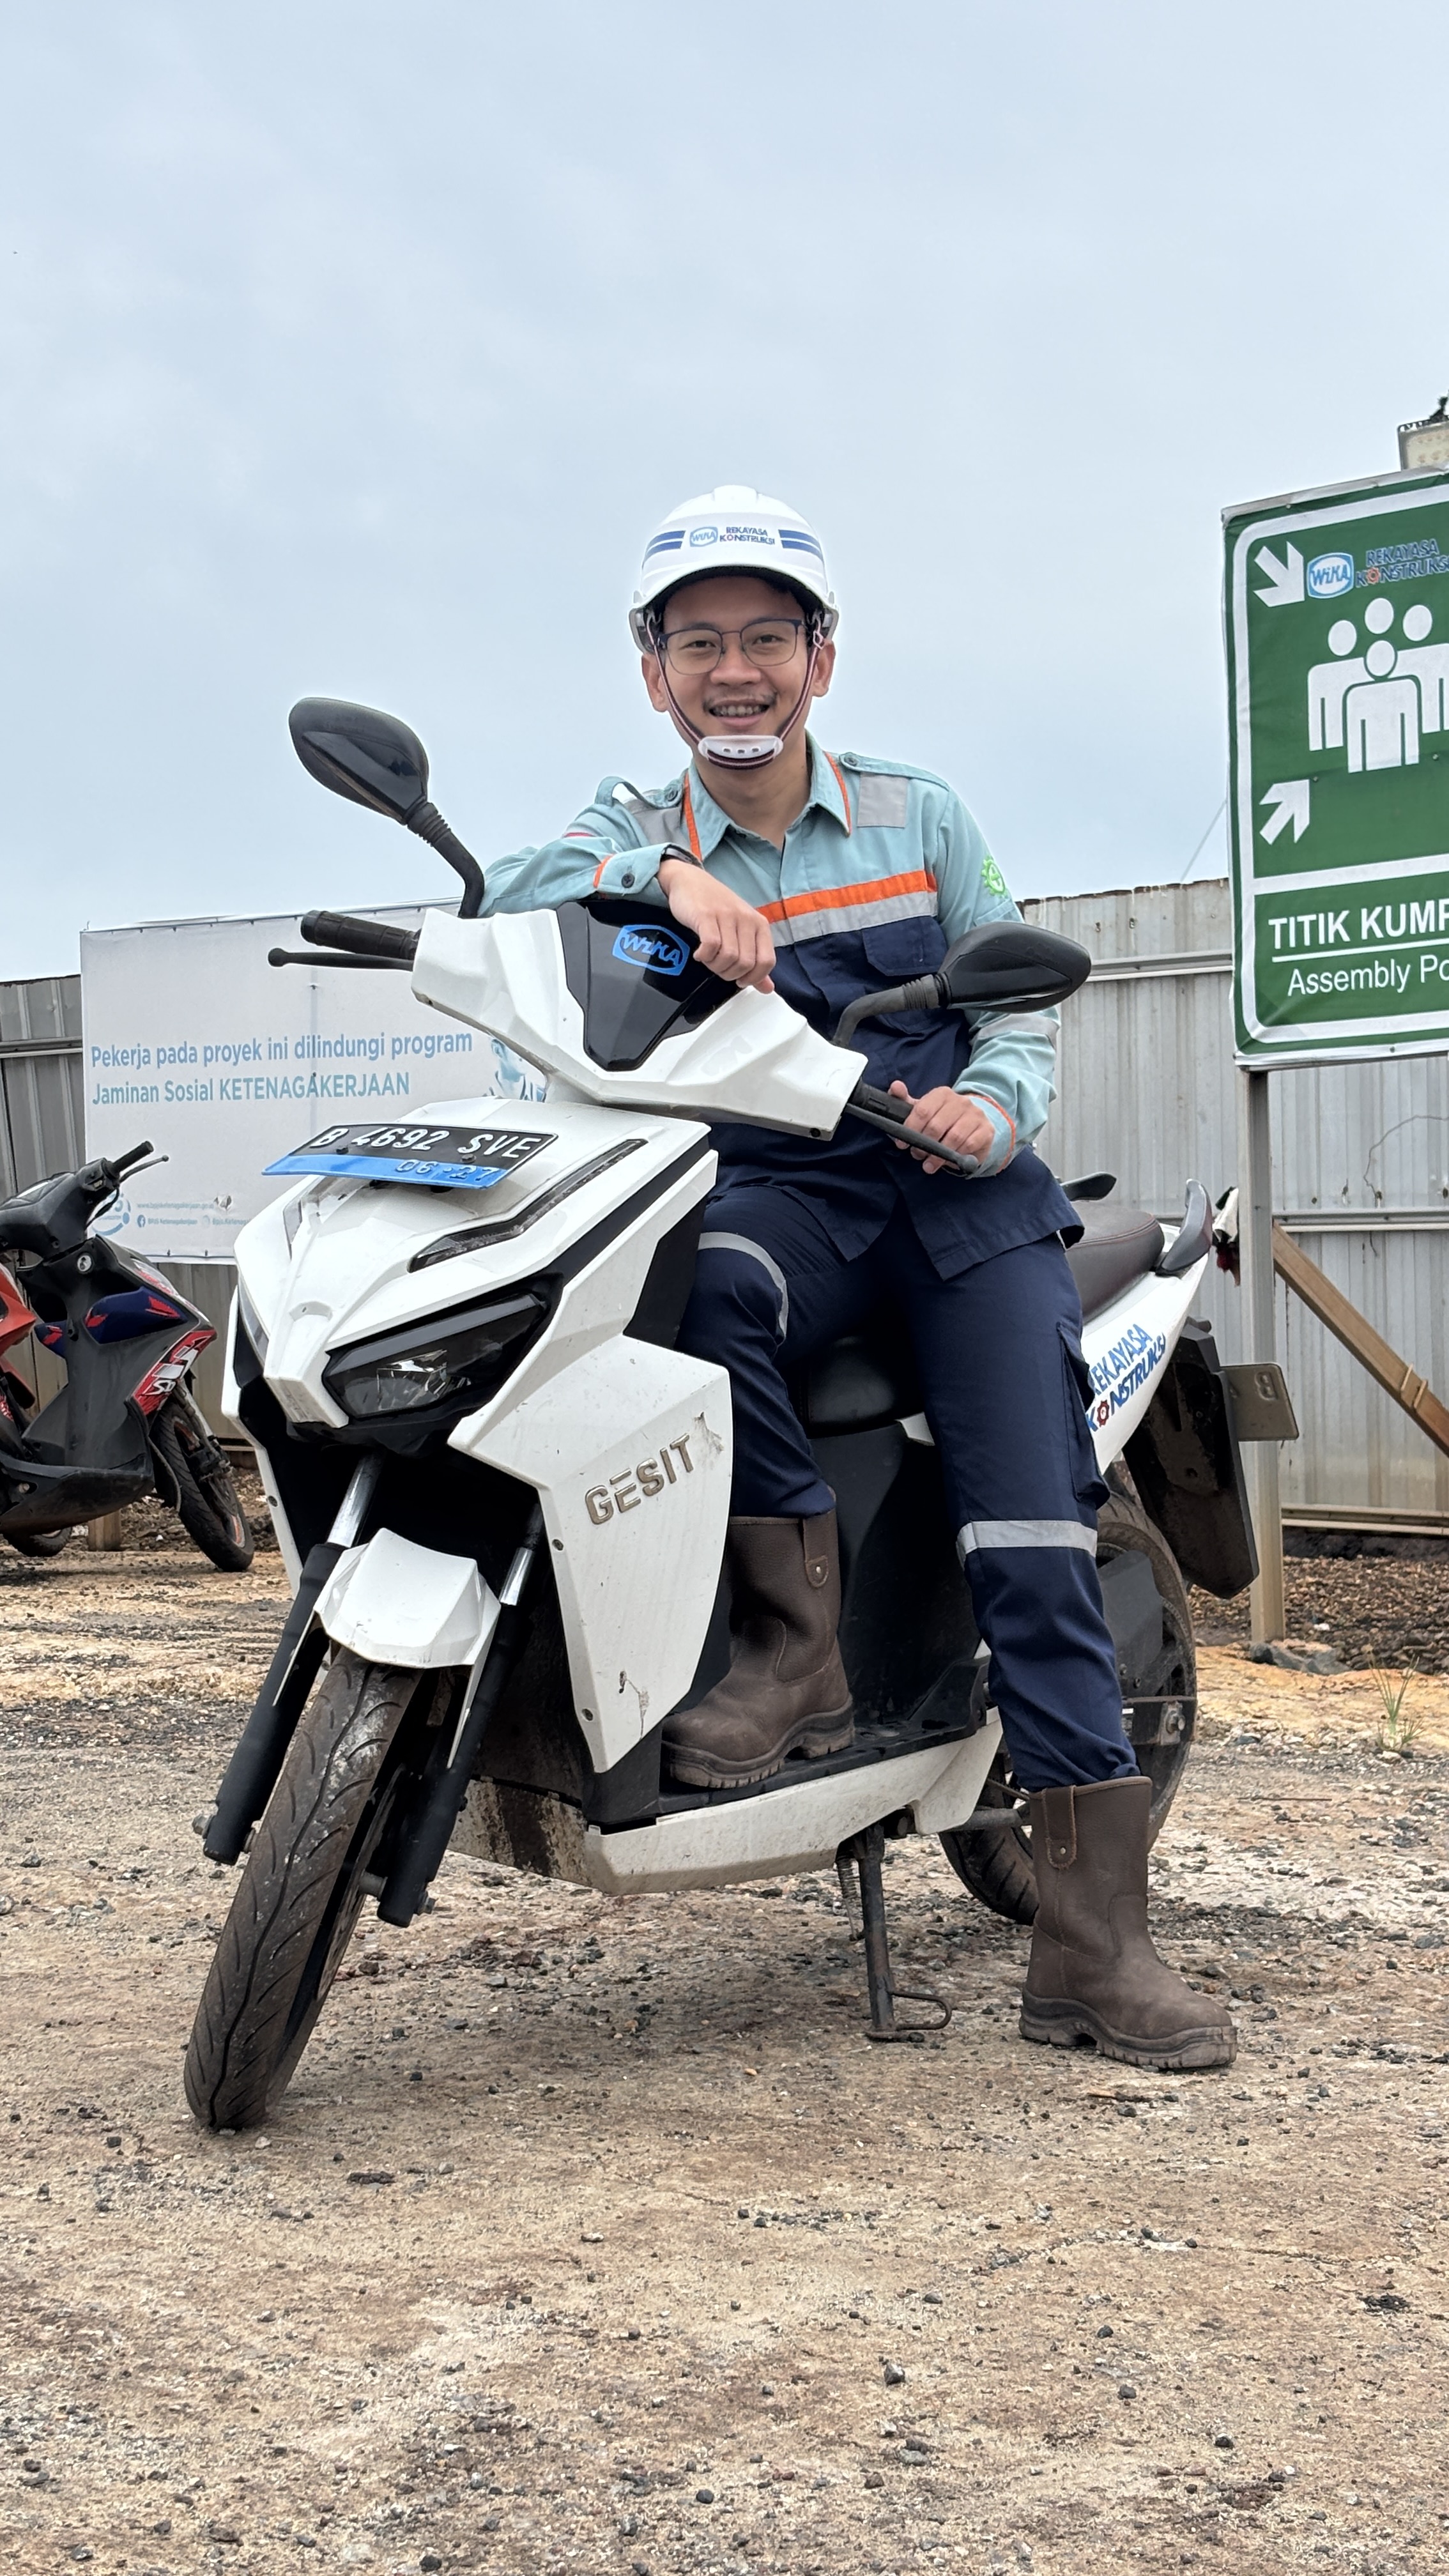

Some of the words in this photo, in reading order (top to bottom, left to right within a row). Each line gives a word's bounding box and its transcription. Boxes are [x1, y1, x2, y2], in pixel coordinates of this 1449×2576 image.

[719, 534, 776, 545] KONSTRUKSI
[726, 526, 768, 536] REKAYASA
[1366, 539, 1439, 567] REKAYASA
[1268, 910, 1351, 949] TITIK
[1287, 958, 1411, 997] Assembly
[91, 1043, 151, 1070] Pekerja
[156, 1041, 198, 1068] pada
[203, 1038, 263, 1067] proyek
[267, 1036, 288, 1061] ini
[294, 1032, 385, 1061] dilindungi
[391, 1032, 473, 1060] program
[92, 1081, 159, 1105] Jaminan
[164, 1078, 213, 1103] Sosial
[219, 1071, 410, 1100] KETENAGAKERJAAN
[310, 1128, 349, 1147] B
[351, 1127, 448, 1150] 4692
[457, 1133, 542, 1158] SVE
[585, 1432, 694, 1525] GESIT
